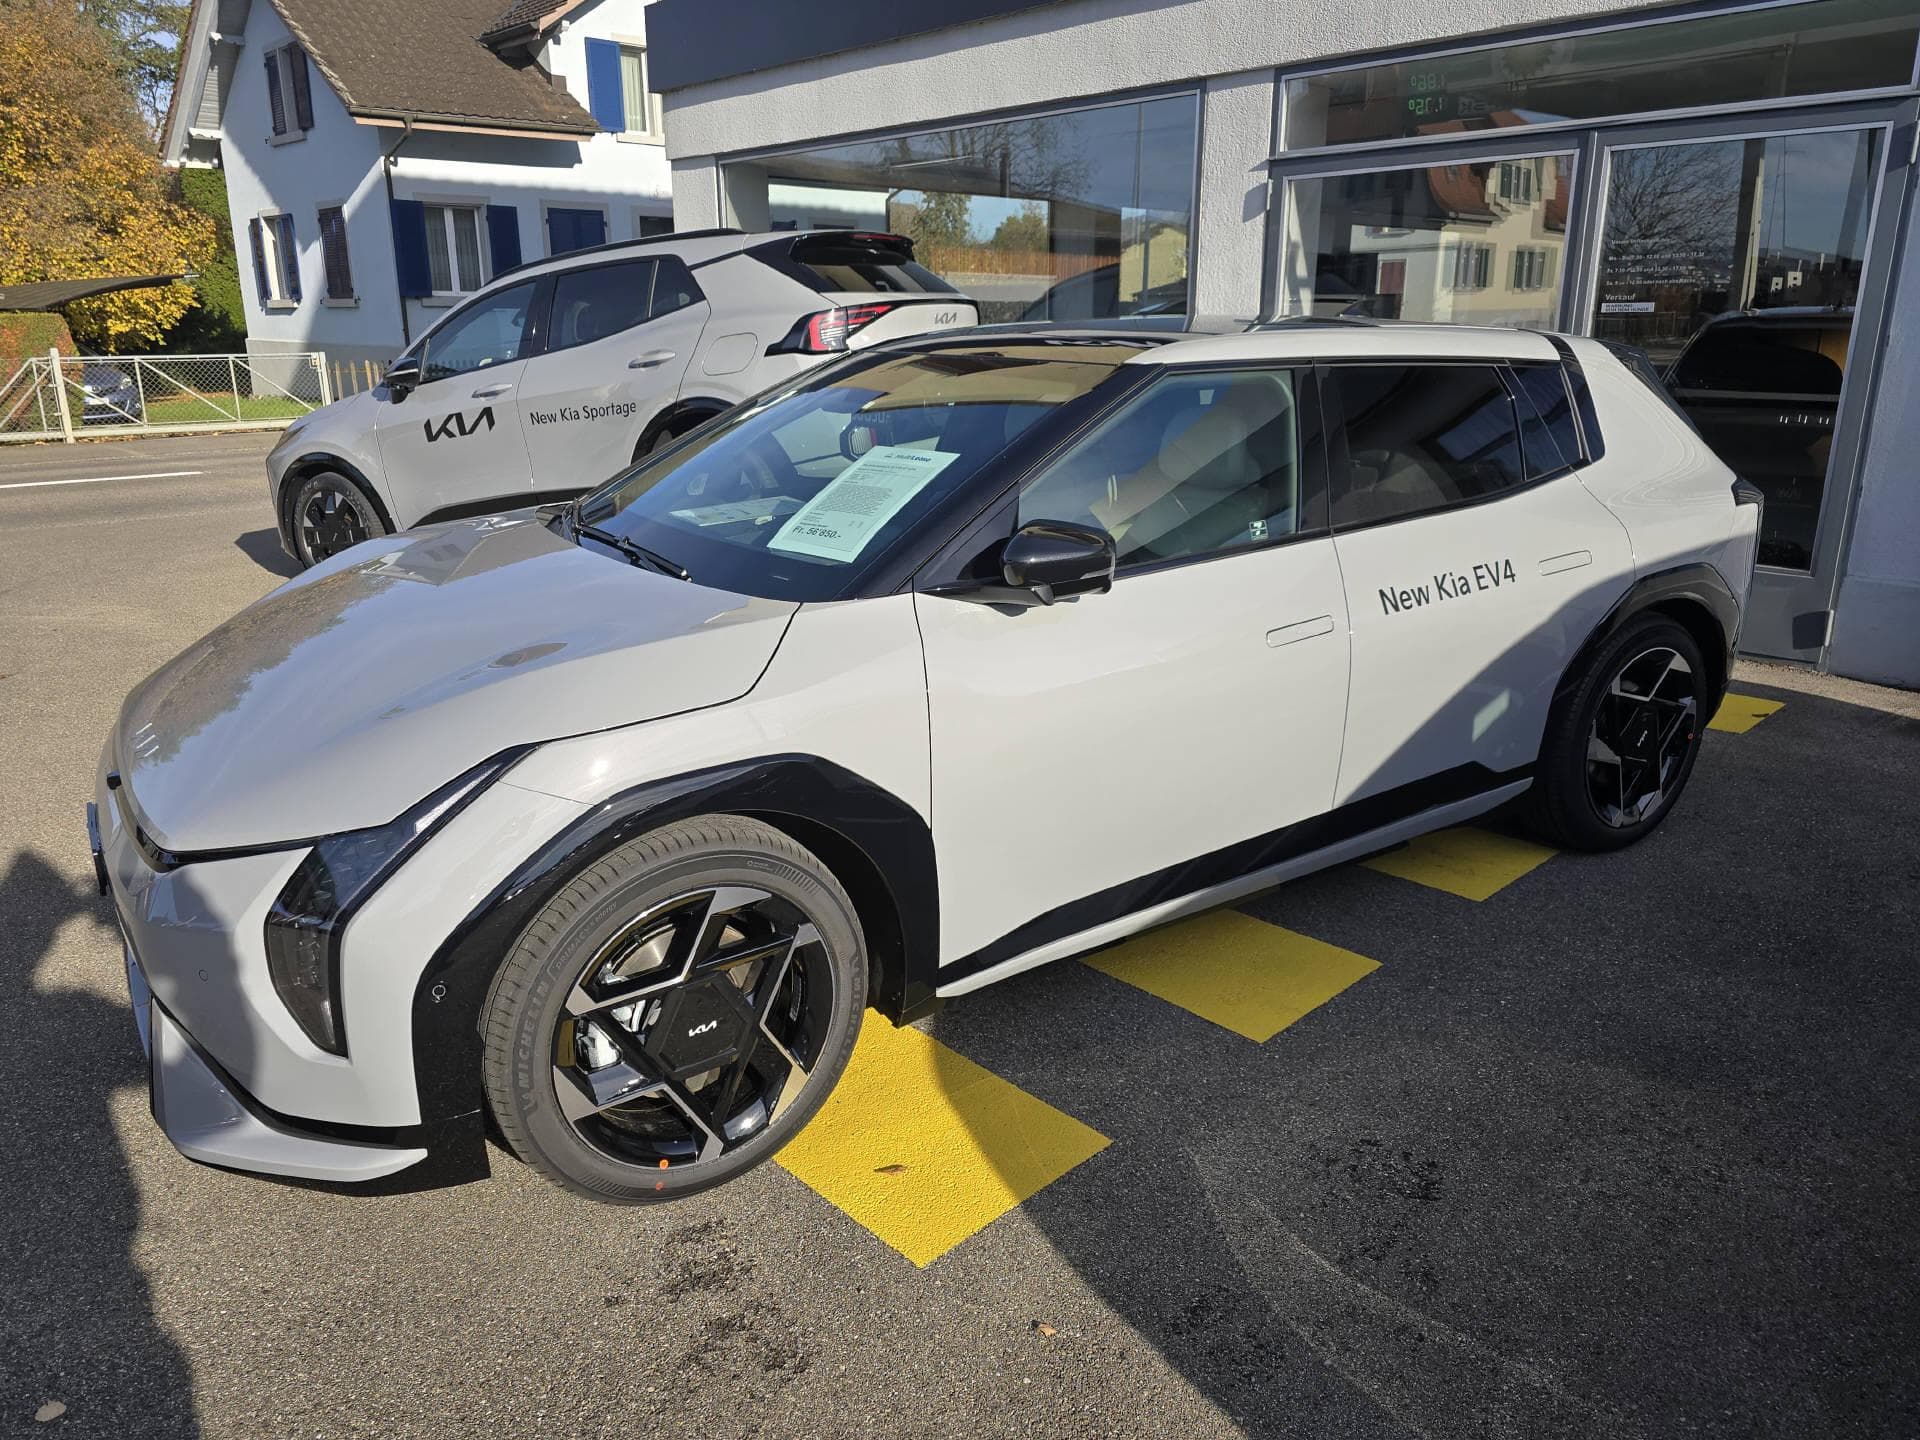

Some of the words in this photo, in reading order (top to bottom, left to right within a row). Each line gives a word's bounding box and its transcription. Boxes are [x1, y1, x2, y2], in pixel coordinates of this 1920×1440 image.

[1605, 293, 1636, 301] Verkauf
[934, 312, 957, 324] KIA
[530, 411, 557, 425] New
[560, 407, 580, 421] Kia
[582, 402, 637, 421] Sportage
[424, 406, 495, 442] KIA
[792, 525, 804, 534] Fr.
[1378, 586, 1430, 615] New
[1433, 572, 1471, 601] Kia
[1472, 558, 1516, 591] EV4
[518, 980, 549, 1088] MICHELIN
[689, 1020, 717, 1037] KIA
